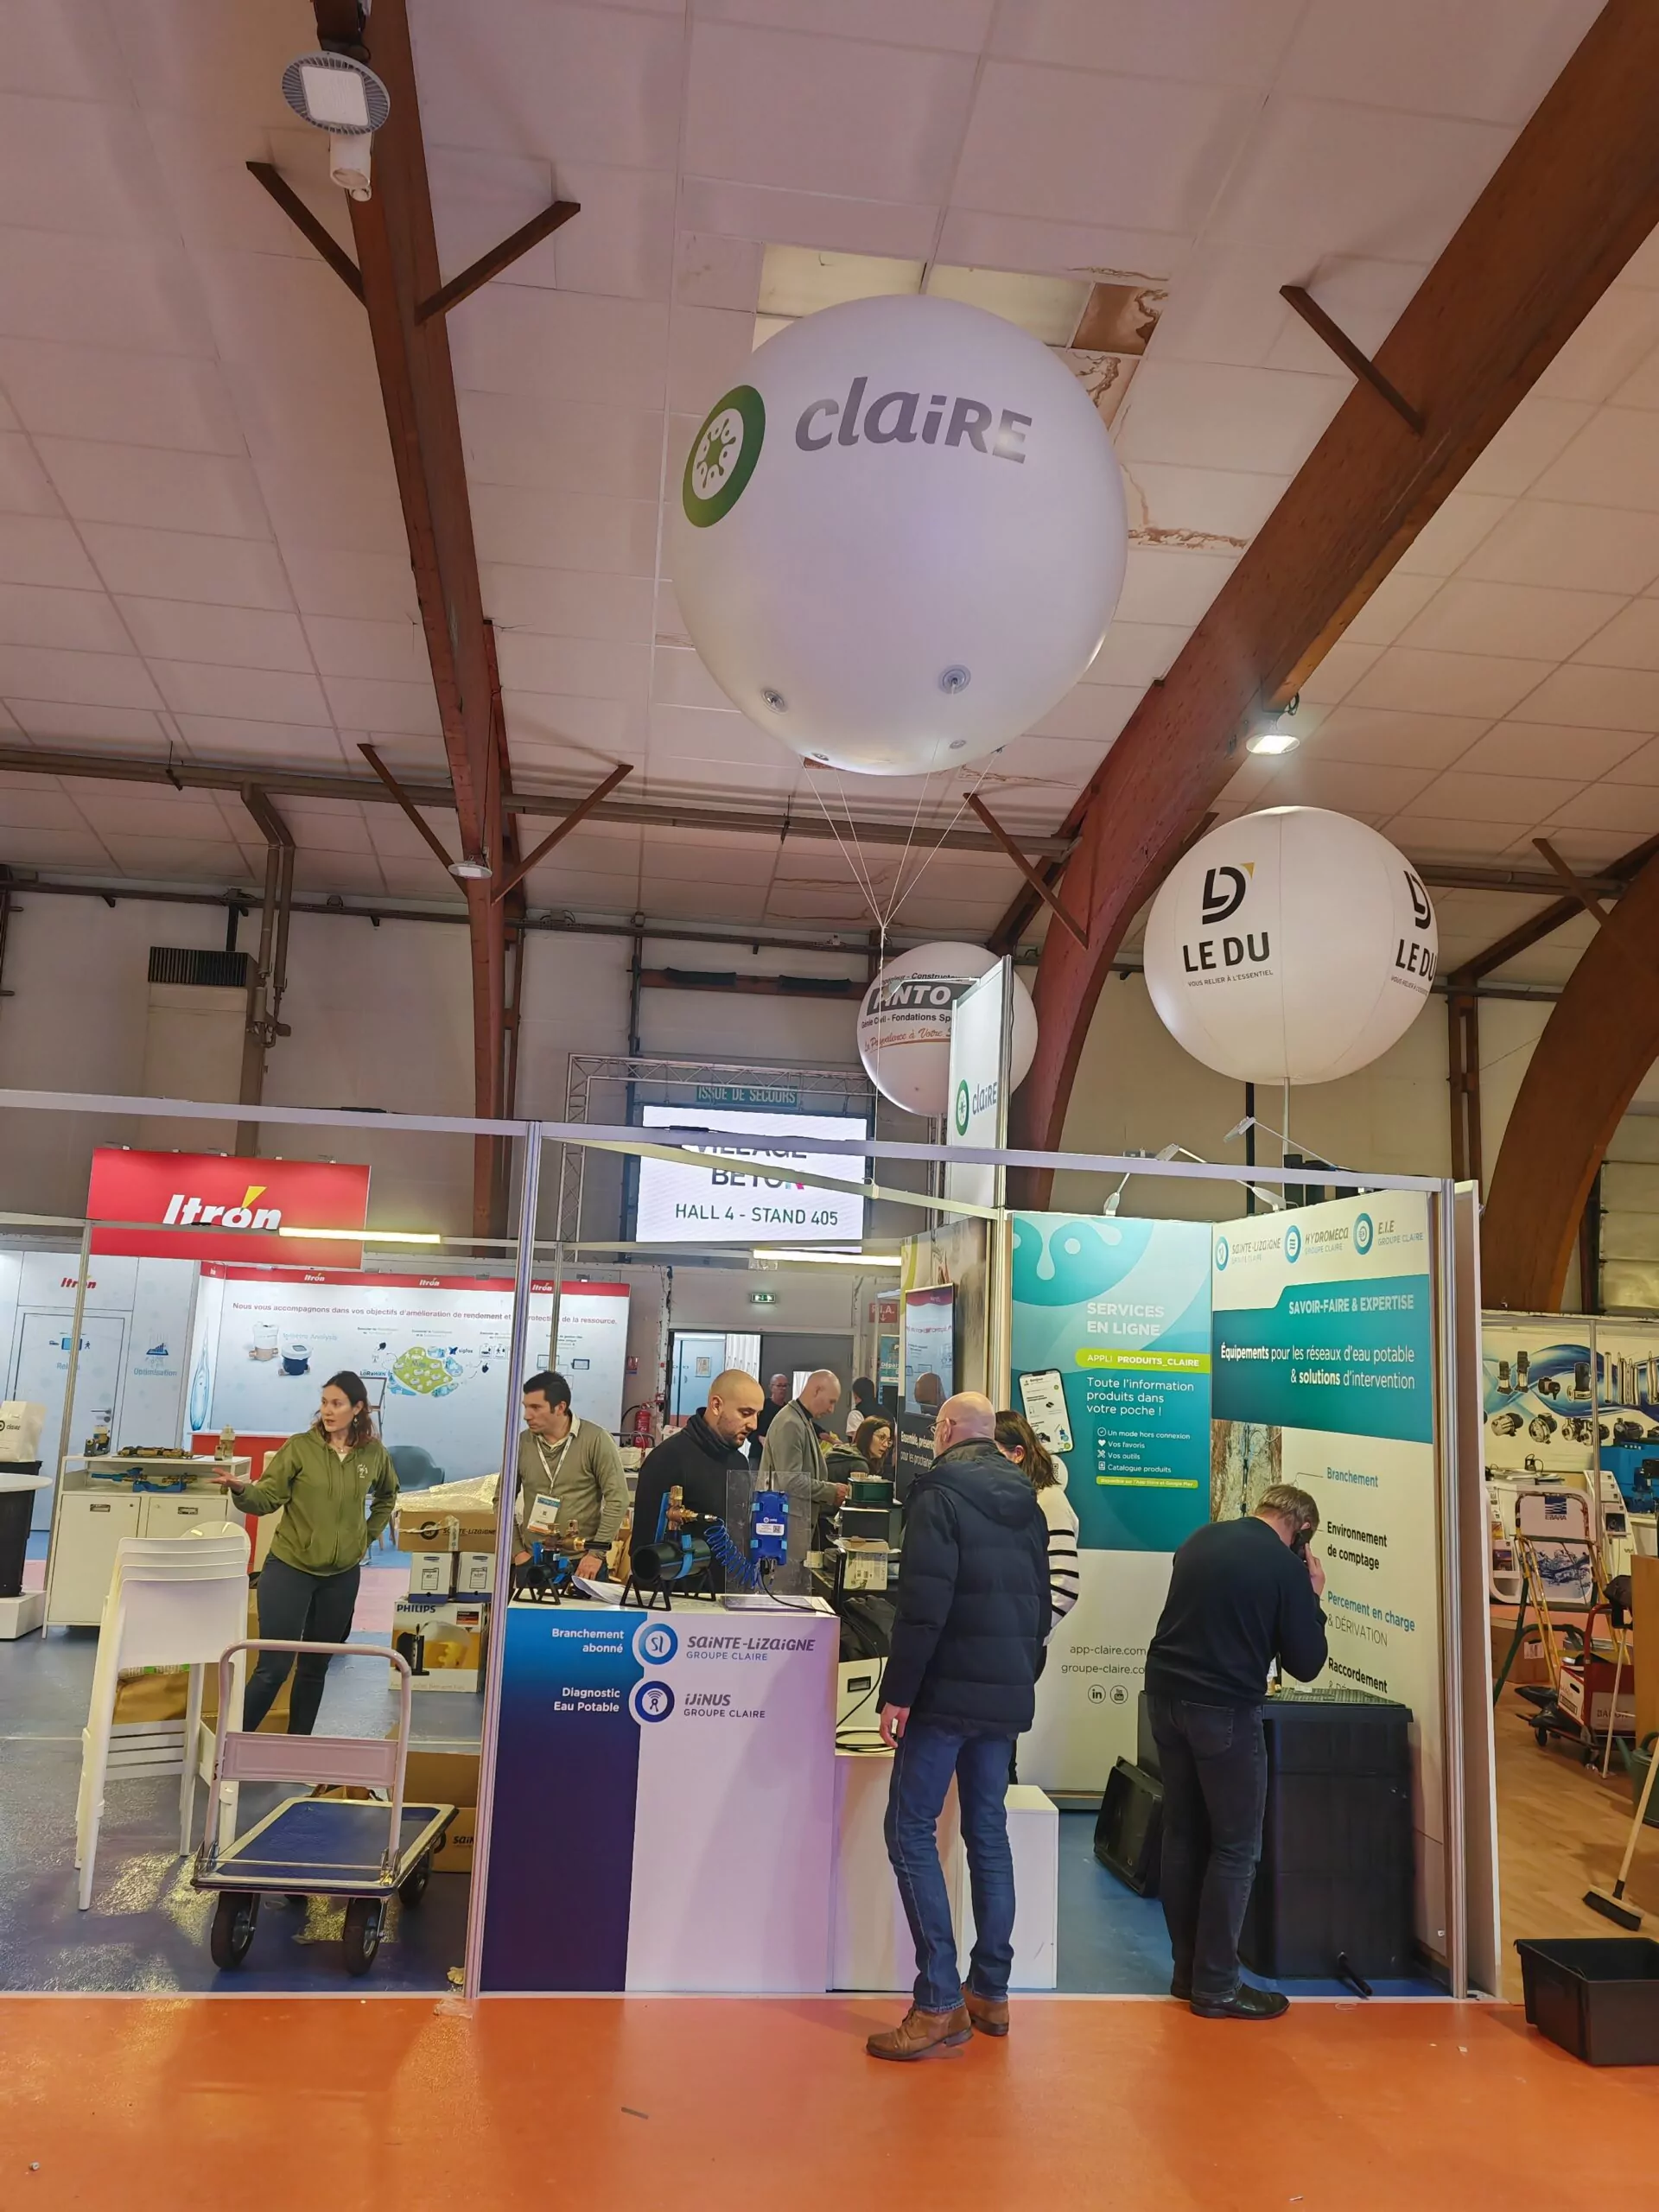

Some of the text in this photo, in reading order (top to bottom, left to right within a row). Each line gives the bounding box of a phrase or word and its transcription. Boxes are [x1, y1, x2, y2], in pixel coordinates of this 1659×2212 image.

[1183, 931, 1270, 973] LE DU
[1395, 938, 1420, 973] LE
[1205, 976, 1225, 985] RELIER
[1232, 969, 1274, 982] L'ESSENTIEL
[892, 1013, 937, 1022] Fondations
[699, 1085, 795, 1104] ISSUE DE SECOURS
[676, 1204, 719, 1220] HALL
[725, 1206, 734, 1220] 4
[752, 1207, 805, 1224] STAND
[811, 1211, 837, 1225] 405
[1378, 1220, 1395, 1235] E.I.E
[1378, 1232, 1423, 1246] GROUPE CLAIRE
[273, 1305, 330, 1314] accompagnons
[366, 1307, 397, 1317] objectifs
[1087, 1302, 1165, 1318] SERVICES
[1289, 1294, 1414, 1314] SAVOIR-FAIRE & EXPERTISE
[1087, 1320, 1160, 1336] EN LIGNE
[1087, 1354, 1199, 1367] APPLI PRODUITS_CLAIRE
[1221, 1342, 1415, 1365] Équipements pour les réseaux d'eau potable
[134, 1368, 177, 1377] Optimisation
[1290, 1369, 1415, 1389] & solutions d'intervention
[1087, 1376, 1194, 1391] Toute l'information
[1087, 1391, 1164, 1403] produits dans
[1087, 1404, 1116, 1414] votre
[1120, 1405, 1155, 1416] poche
[1327, 1467, 1378, 1488] Branchement
[1327, 1521, 1388, 1548] Environnement
[1327, 1544, 1380, 1571] de comptage
[397, 1604, 435, 1613] PHILIPS
[1328, 1591, 1415, 1631] Percement en charge
[552, 1628, 624, 1640] Branchement
[1328, 1613, 1388, 1647] & DÉRIVATION
[582, 1642, 623, 1654] abonné
[1070, 1645, 1146, 1656] app-claire.com
[686, 1650, 767, 1662] GROUPE CLAIRE
[1328, 1656, 1388, 1694] Raccordement
[562, 1687, 620, 1700] Diagnostic
[554, 1700, 620, 1713] Eau Potable
[683, 1708, 766, 1719] GROUPE CLAIRE
